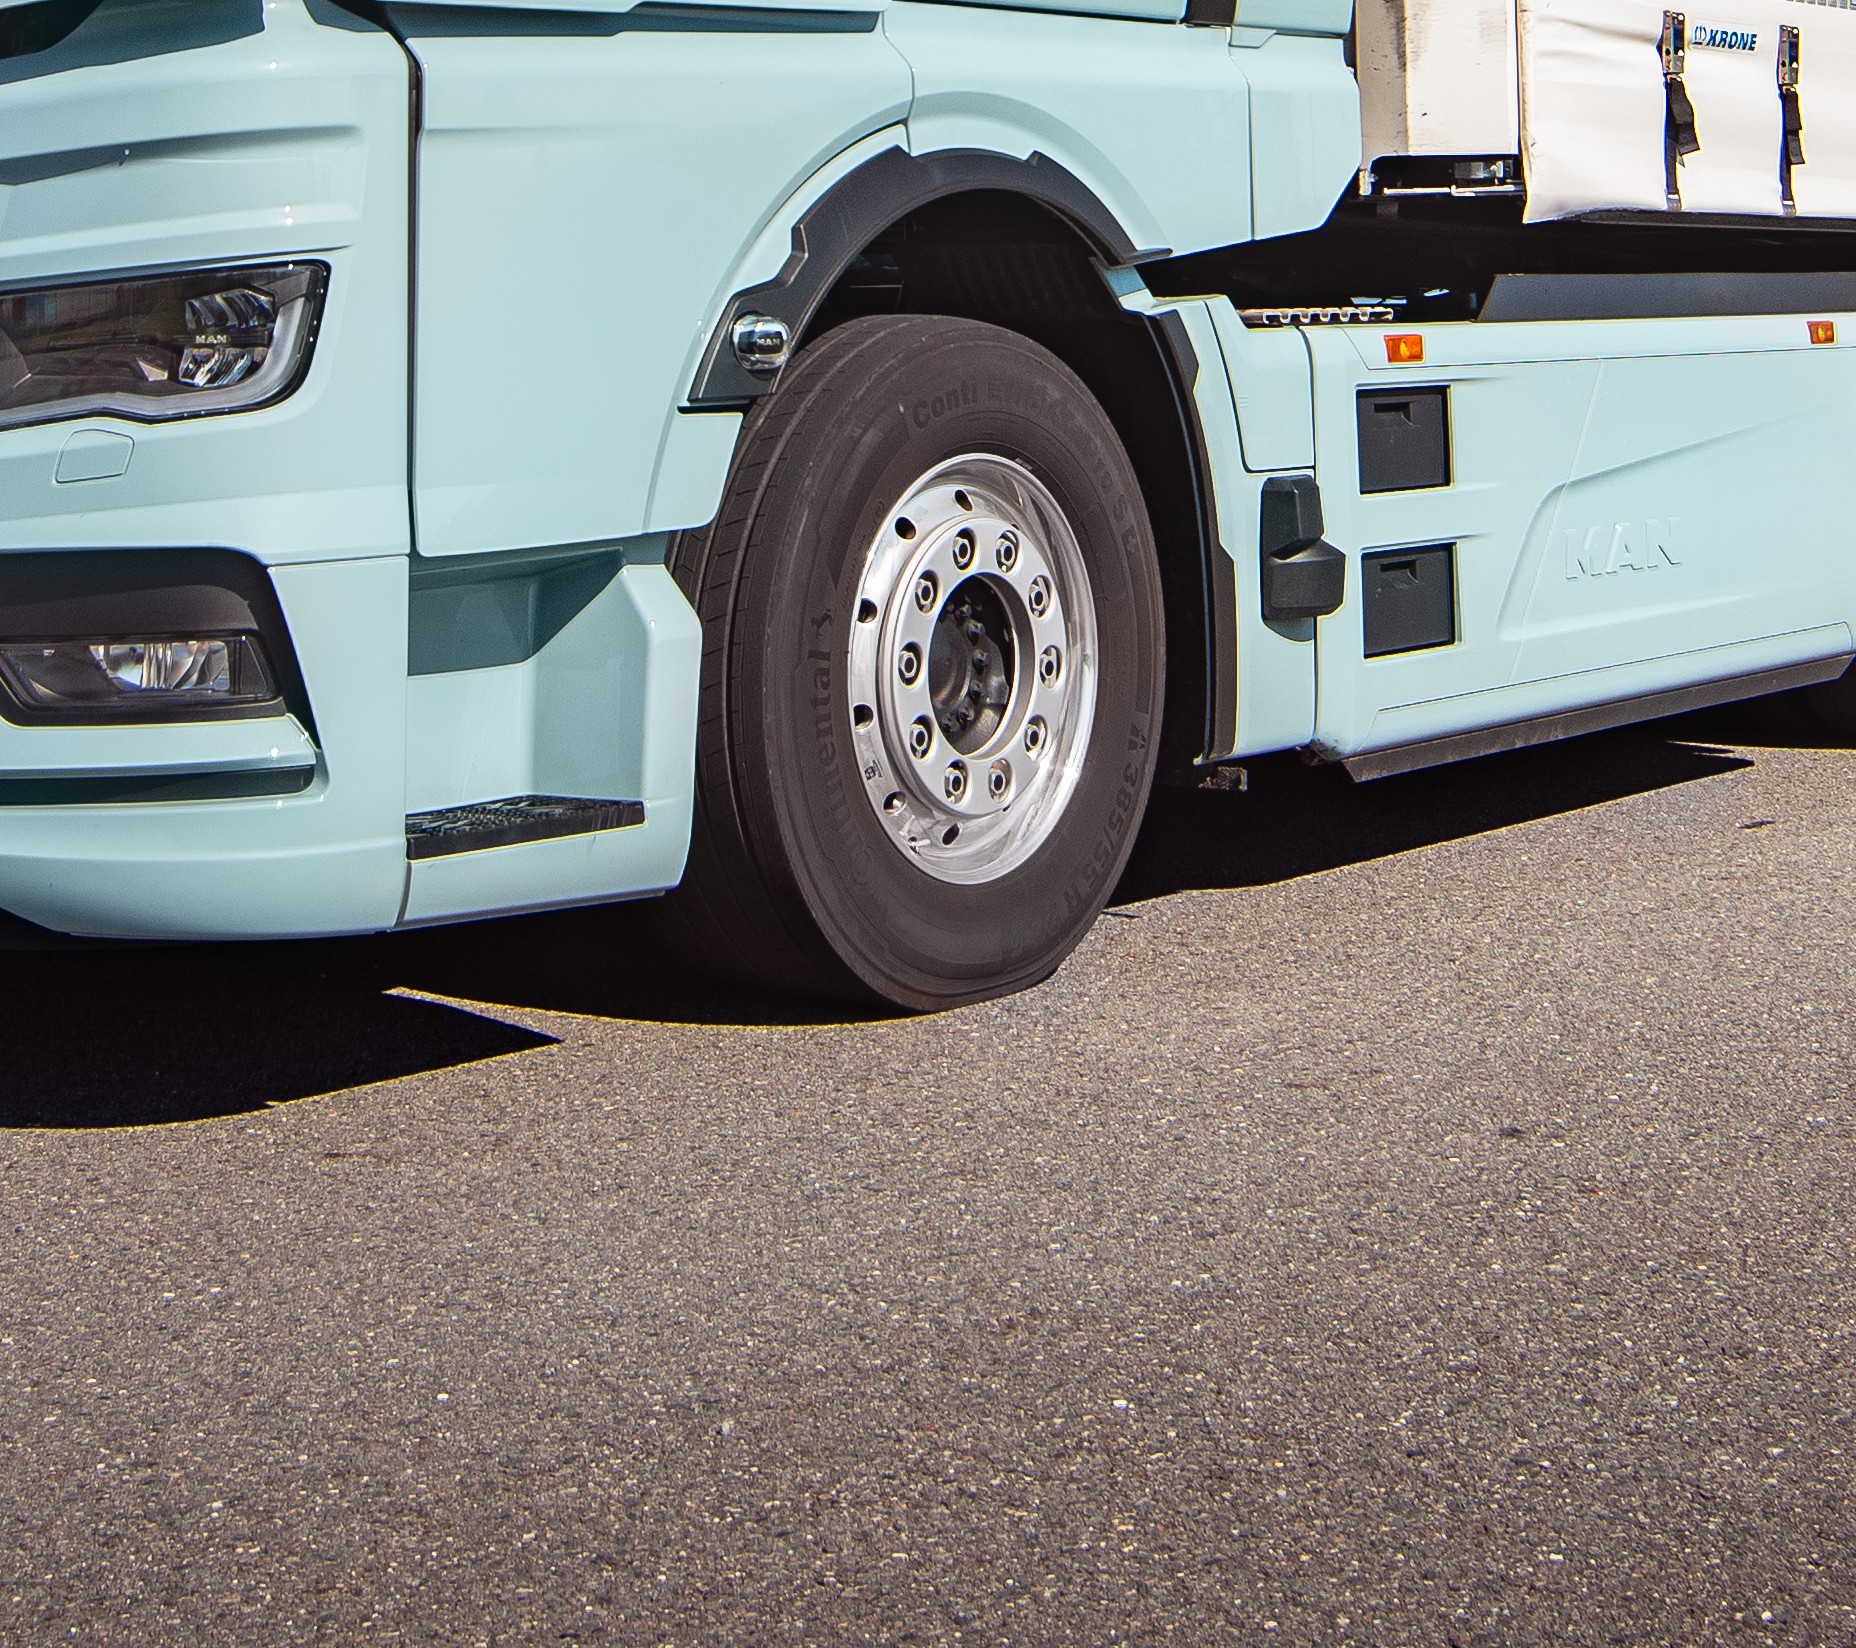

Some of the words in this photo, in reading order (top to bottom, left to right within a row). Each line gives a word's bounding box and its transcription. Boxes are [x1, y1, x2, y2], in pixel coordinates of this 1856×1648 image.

[1706, 28, 1758, 52] KRONE
[195, 334, 227, 344] MAN
[1564, 516, 1682, 581] MAN
